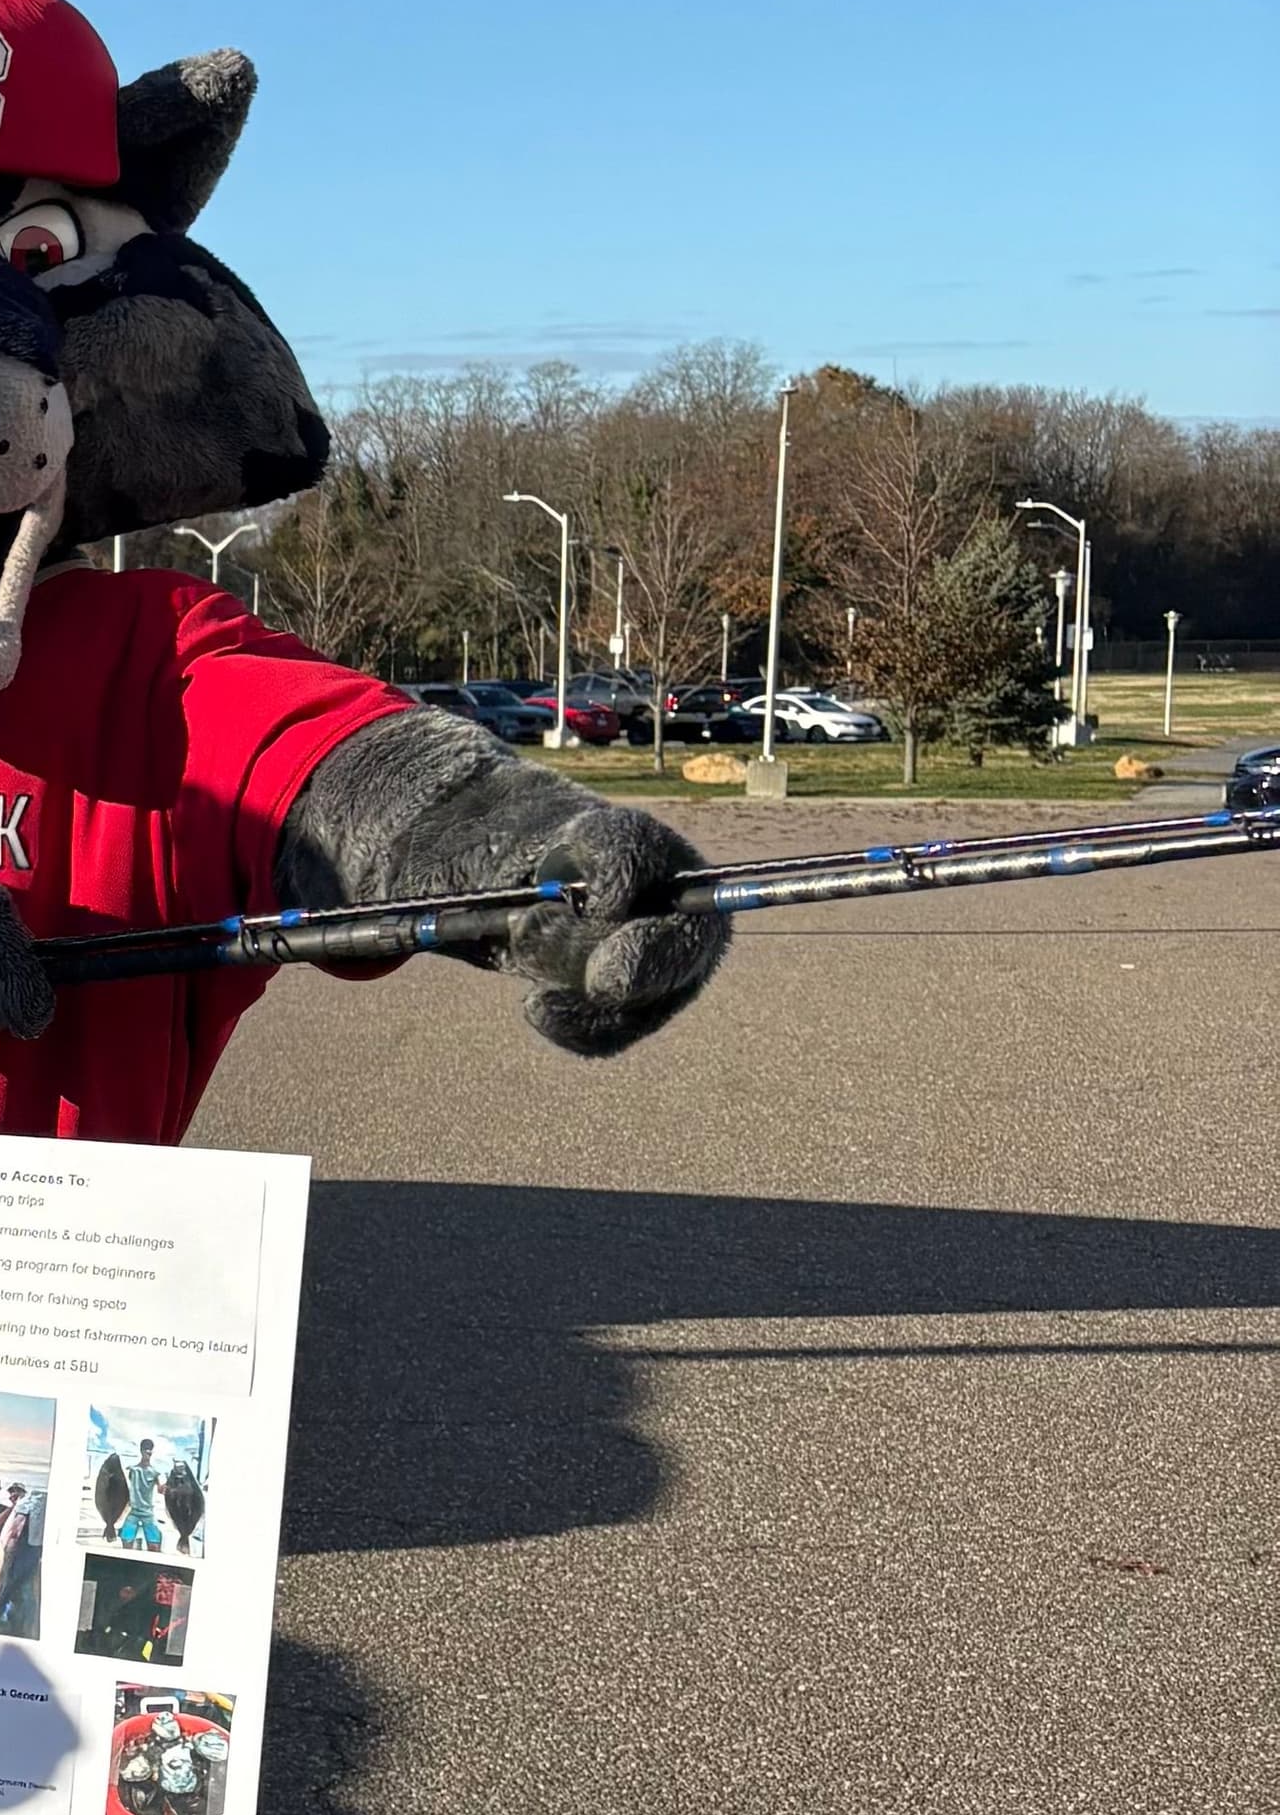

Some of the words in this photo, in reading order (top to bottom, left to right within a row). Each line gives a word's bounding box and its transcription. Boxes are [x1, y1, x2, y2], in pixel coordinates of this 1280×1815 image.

[11, 1170, 63, 1184] Access
[68, 1173, 89, 1187] To:
[17, 1194, 45, 1208] trips
[61, 1229, 70, 1240] &
[74, 1230, 101, 1243] club
[104, 1232, 174, 1251] challenges
[15, 1259, 68, 1274] program
[71, 1262, 89, 1274] for
[92, 1264, 156, 1281] beginners
[27, 1291, 44, 1303] for
[47, 1292, 89, 1310] fishing
[92, 1298, 127, 1311] spots
[29, 1324, 50, 1336] the
[53, 1326, 80, 1339] best
[83, 1328, 147, 1345] fishermen
[150, 1336, 168, 1347] on
[171, 1335, 204, 1353] Long
[208, 1340, 248, 1354] Island
[53, 1359, 66, 1370] at
[69, 1359, 98, 1373] SBU
